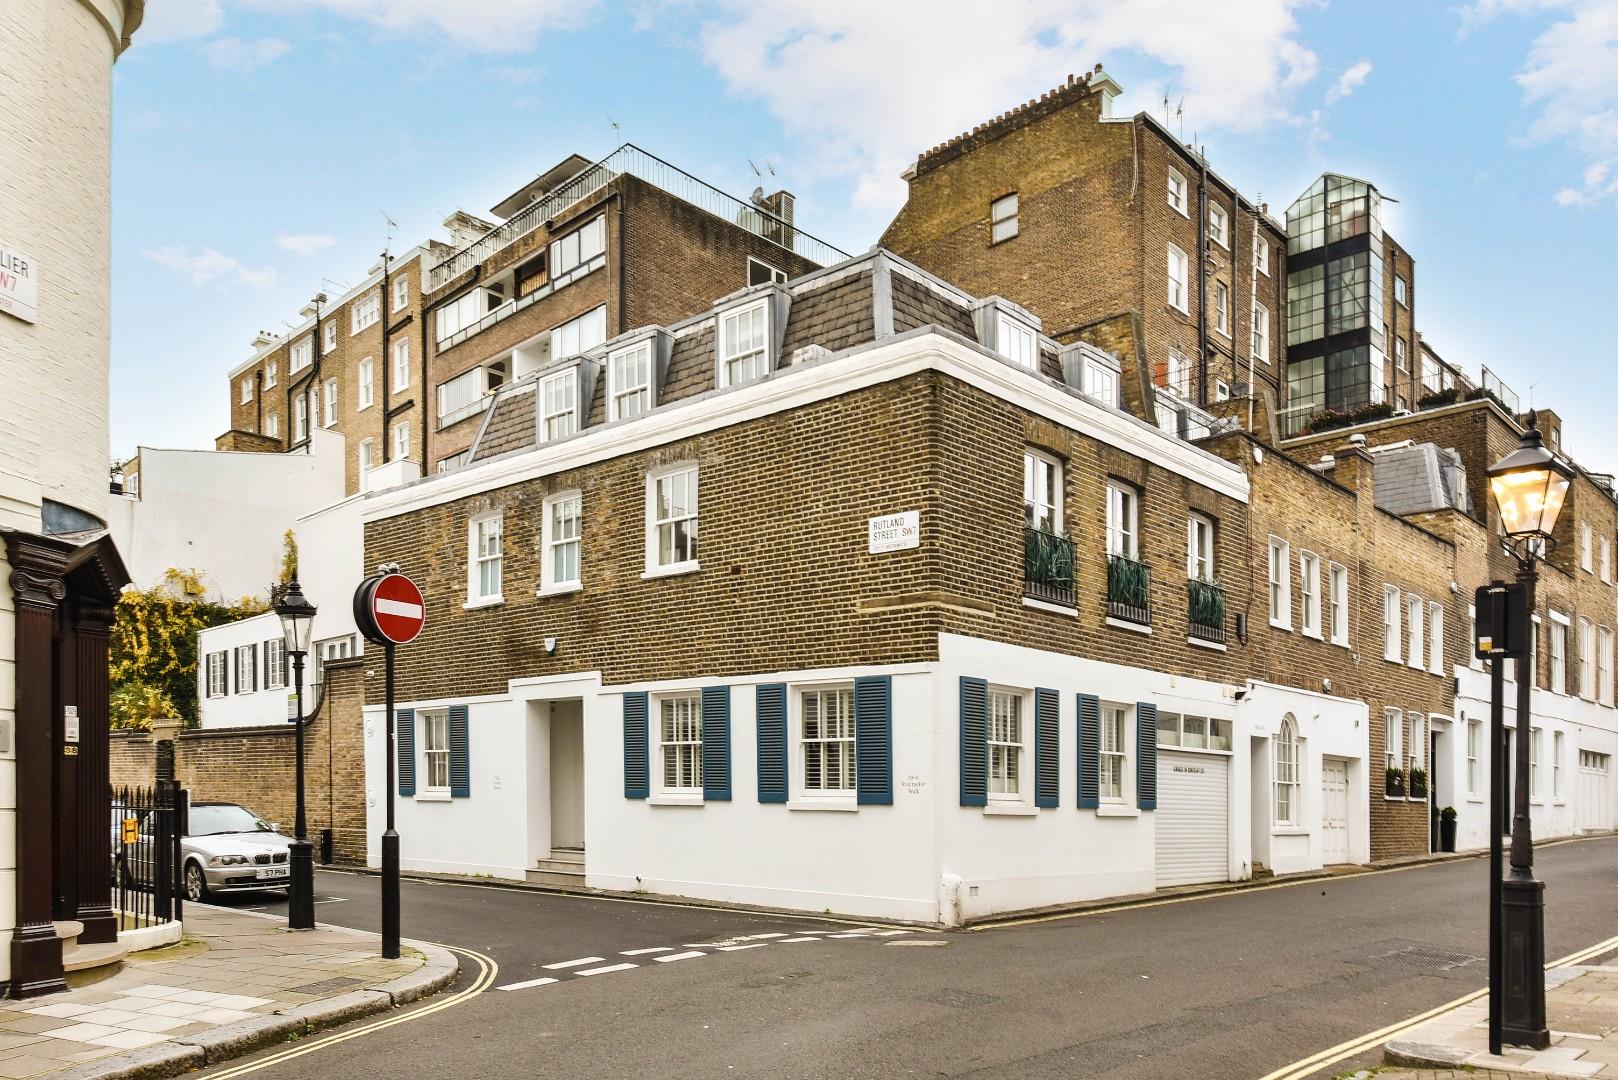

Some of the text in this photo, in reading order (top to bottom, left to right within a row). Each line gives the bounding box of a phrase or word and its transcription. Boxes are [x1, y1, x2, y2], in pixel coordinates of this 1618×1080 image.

[873, 517, 905, 530] RUTLAND
[873, 526, 917, 541] STREET SW7
